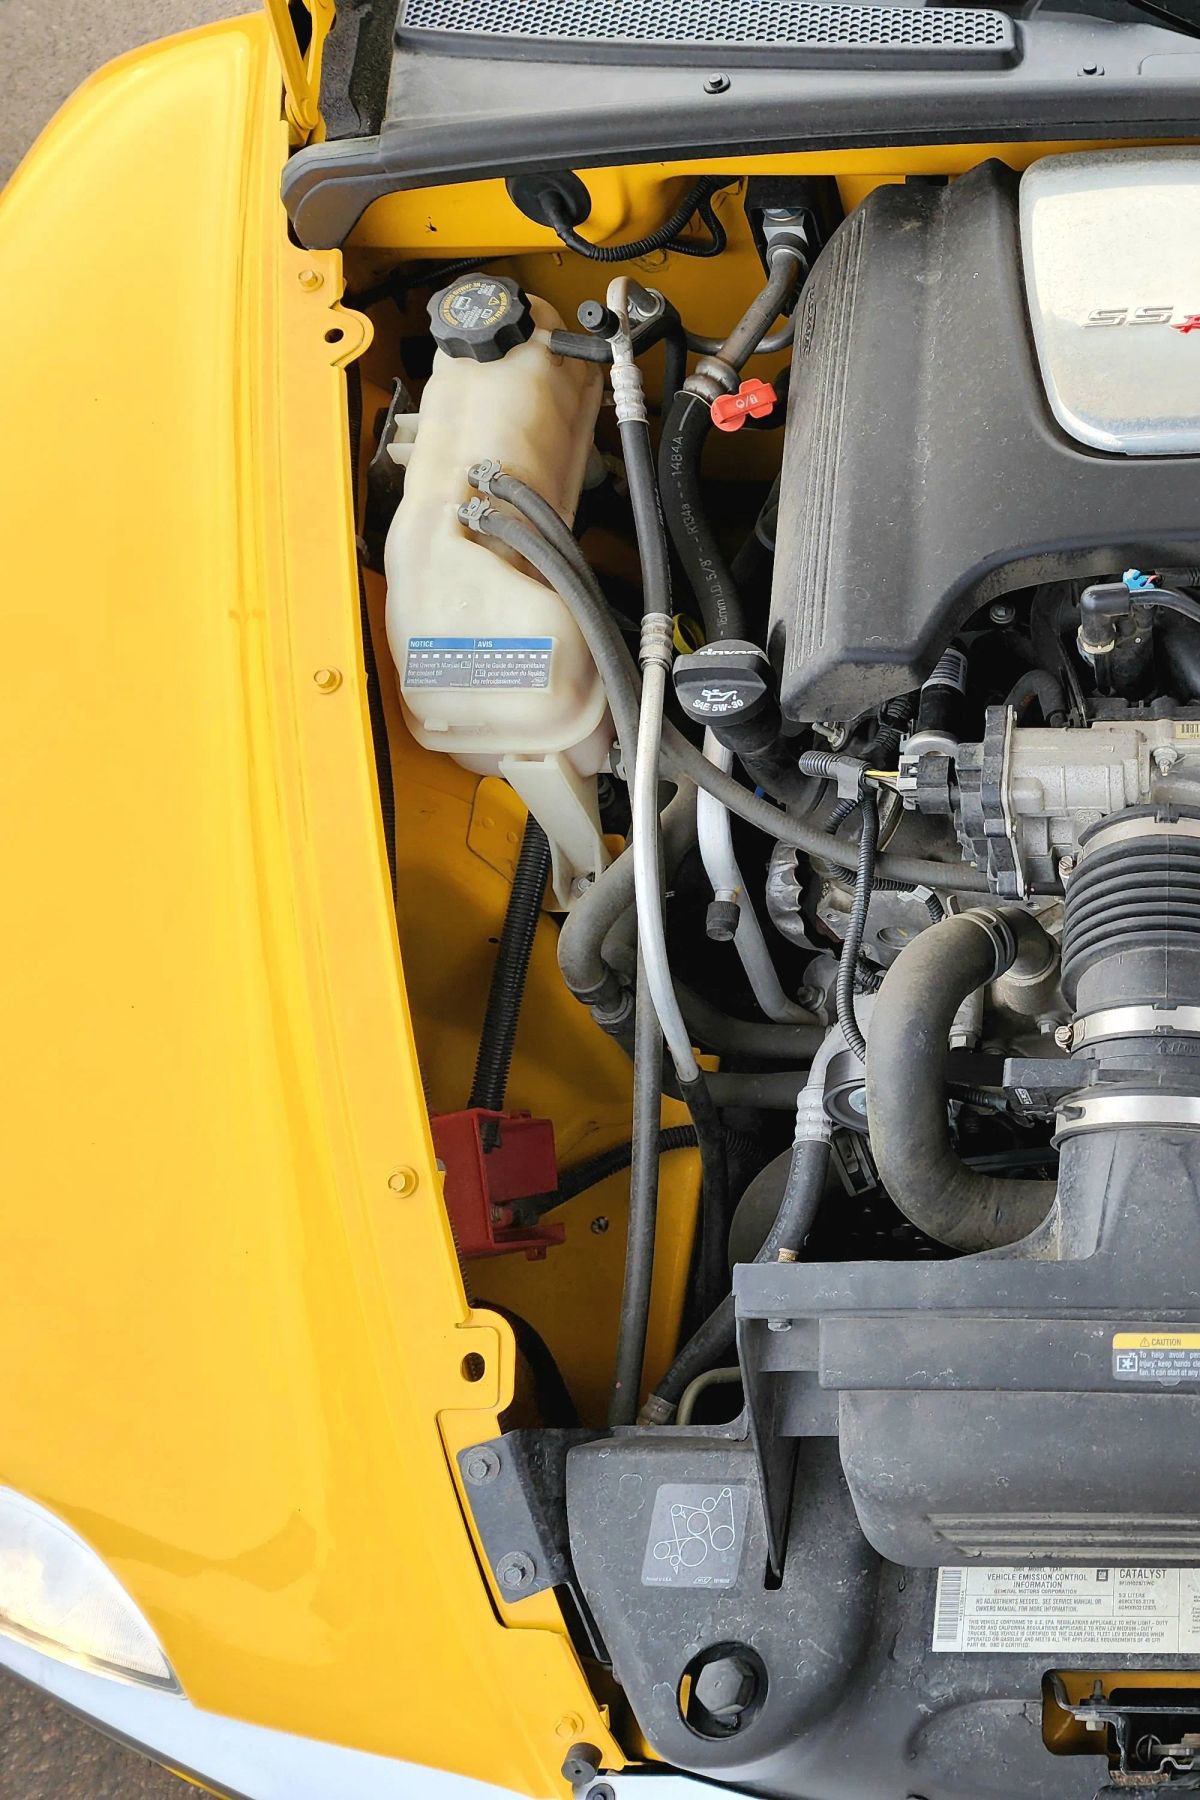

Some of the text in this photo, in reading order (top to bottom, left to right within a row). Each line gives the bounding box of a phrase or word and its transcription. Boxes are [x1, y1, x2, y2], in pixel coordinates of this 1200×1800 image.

[671, 436, 683, 476] 1484A
[681, 503, 699, 535] R134a
[410, 640, 434, 648] NOTICE
[692, 699, 744, 712] SAE 5W-30
[1157, 1360, 1172, 1368] keep
[1119, 1569, 1167, 1578] CATALYST
